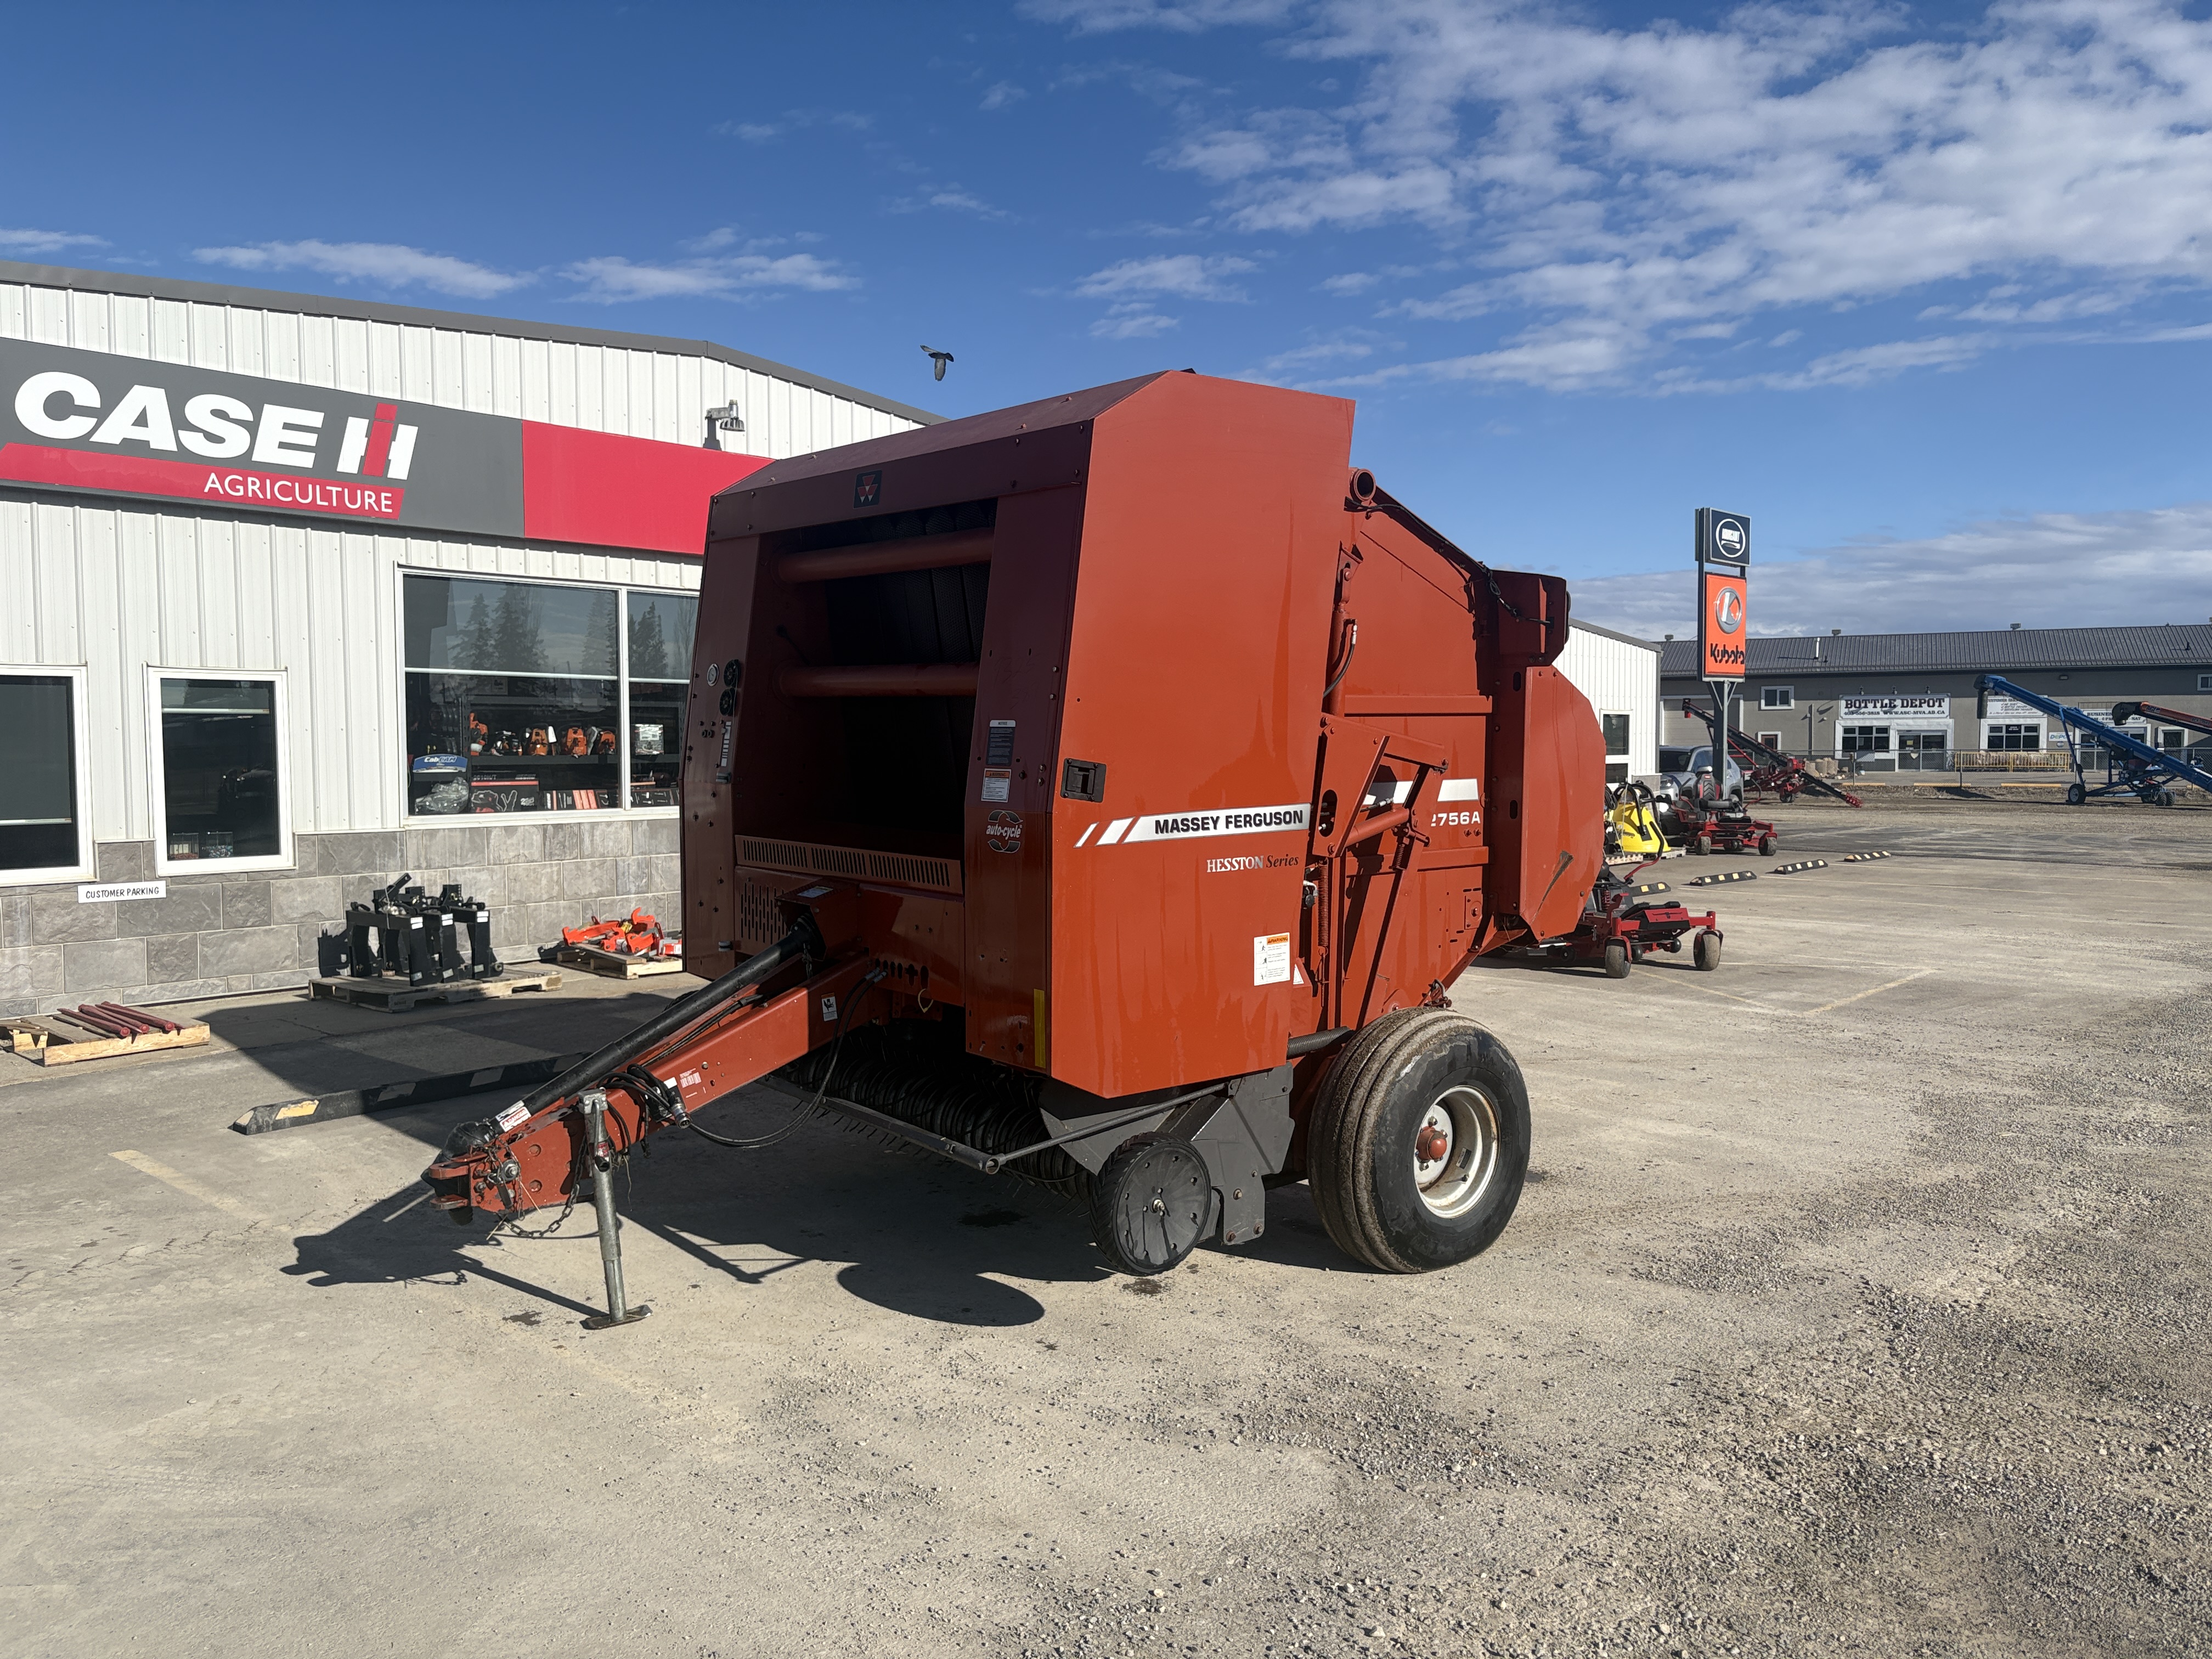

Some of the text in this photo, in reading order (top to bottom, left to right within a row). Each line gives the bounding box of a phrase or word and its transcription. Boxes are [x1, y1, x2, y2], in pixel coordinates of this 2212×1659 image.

[15, 371, 325, 468] CASE
[204, 472, 393, 513] AGRICULTURE
[1710, 643, 1745, 665] Kubota
[1844, 698, 1945, 708] BOTTLE DEPOT
[1154, 809, 1304, 834] MASSEY FERGUSON
[1207, 854, 1299, 872] HESSTON Series
[86, 887, 160, 899] CUSTOMER PARKING
